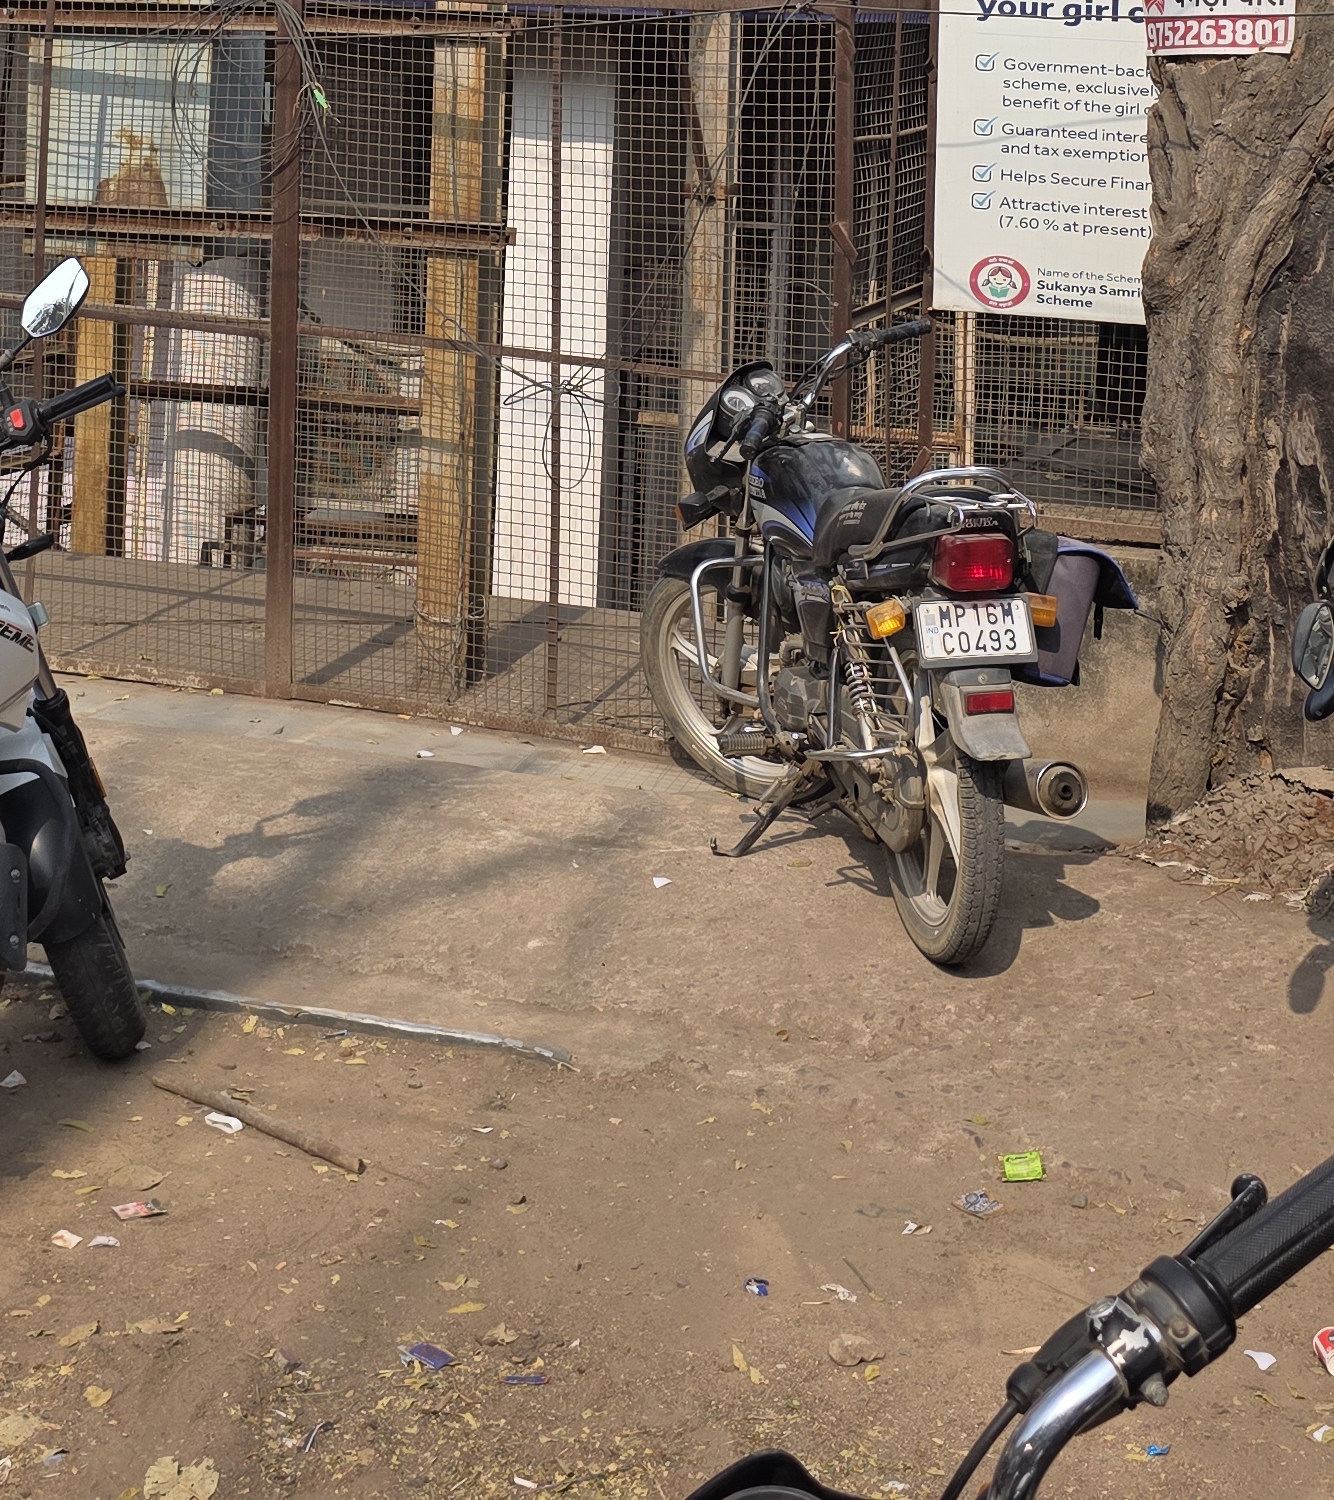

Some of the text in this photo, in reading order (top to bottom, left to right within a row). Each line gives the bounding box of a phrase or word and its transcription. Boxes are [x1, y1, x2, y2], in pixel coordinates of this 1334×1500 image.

[1147, 18, 1286, 48] 9752263801
[1002, 77, 1071, 94] scheme,
[1002, 94, 1060, 111] benefit
[1063, 99, 1081, 112] of
[1084, 100, 1112, 113] the
[1114, 102, 1140, 117] girl
[1001, 122, 1098, 141] Guaranteed
[1000, 142, 1030, 155] and
[1033, 143, 1060, 157] tax
[1000, 168, 1047, 186] Helps
[1050, 172, 1107, 188] Secure
[999, 196, 1148, 219] Attractive interest
[999, 214, 1040, 230] (7.60
[1062, 221, 1079, 233] at
[1082, 223, 1153, 240] present)
[1037, 267, 1070, 279] Name
[1071, 270, 1084, 280] of
[1085, 271, 1104, 281] the
[1036, 280, 1096, 296] Sukanya
[1036, 293, 1093, 308] Scheme
[938, 601, 1015, 629] MP16M
[925, 626, 939, 635] IND
[942, 628, 1017, 656] C0493
